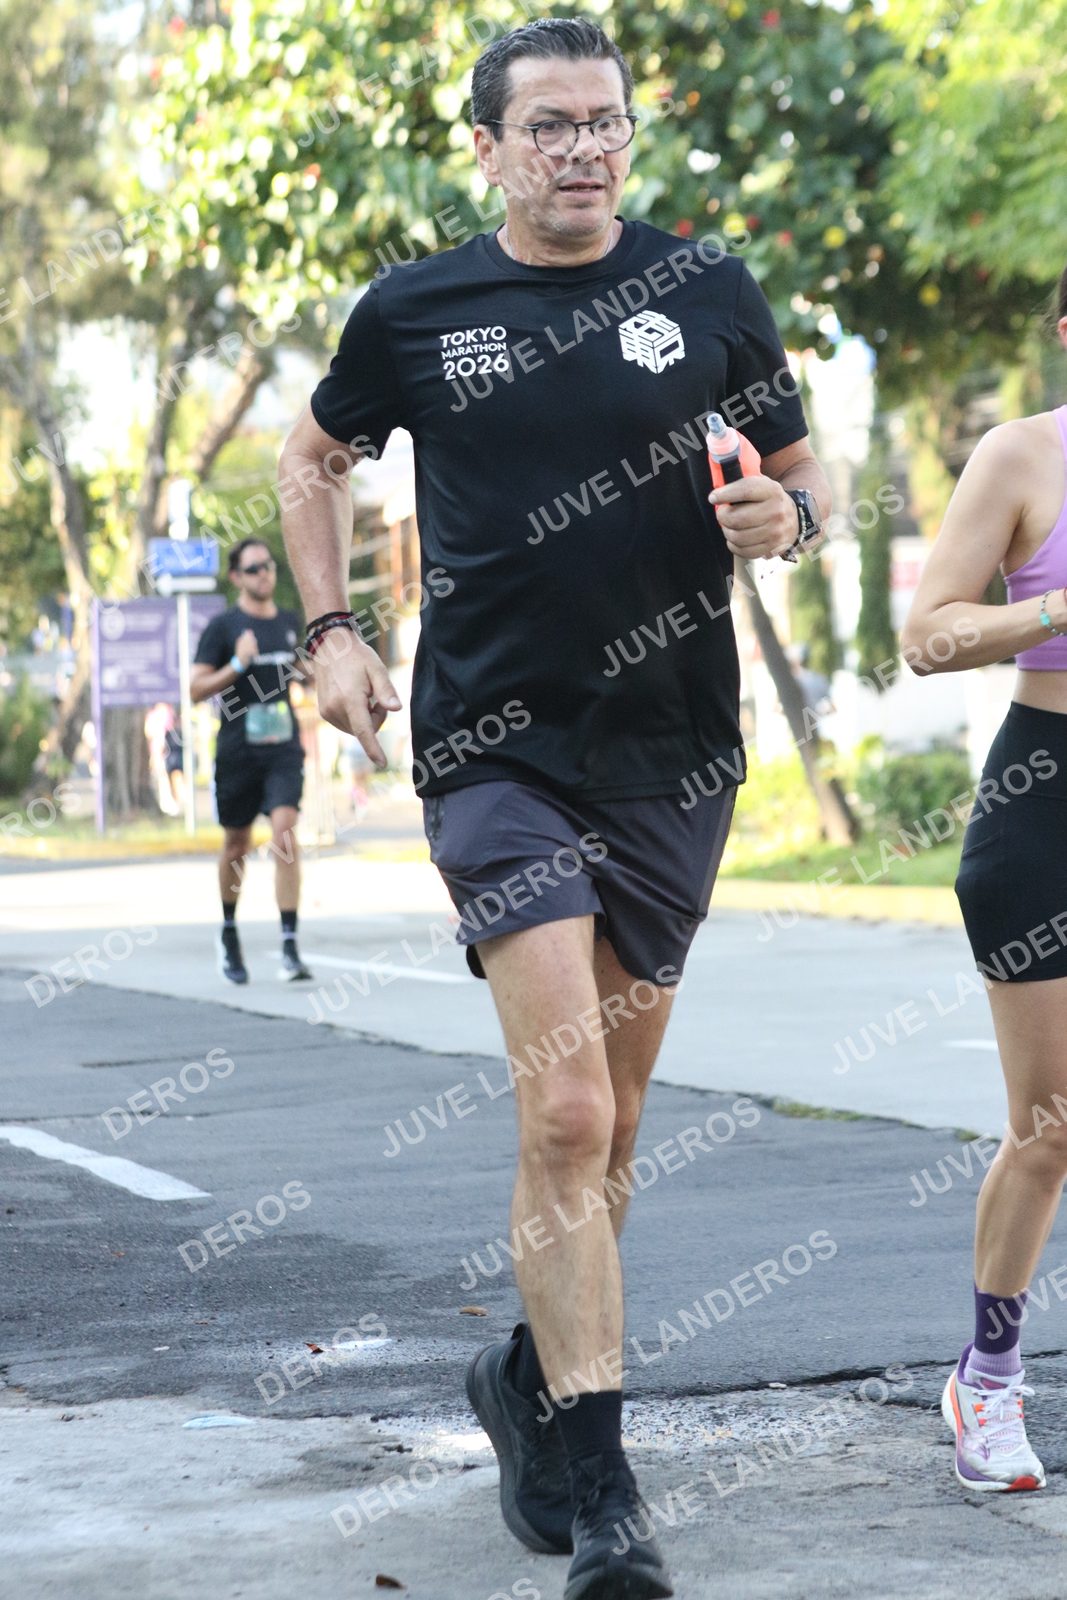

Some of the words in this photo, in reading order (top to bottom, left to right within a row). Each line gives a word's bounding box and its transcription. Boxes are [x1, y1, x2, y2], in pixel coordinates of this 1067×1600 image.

[440, 326, 507, 348] TOKYO
[441, 342, 507, 360] MARATHON
[443, 353, 510, 380] 2026
